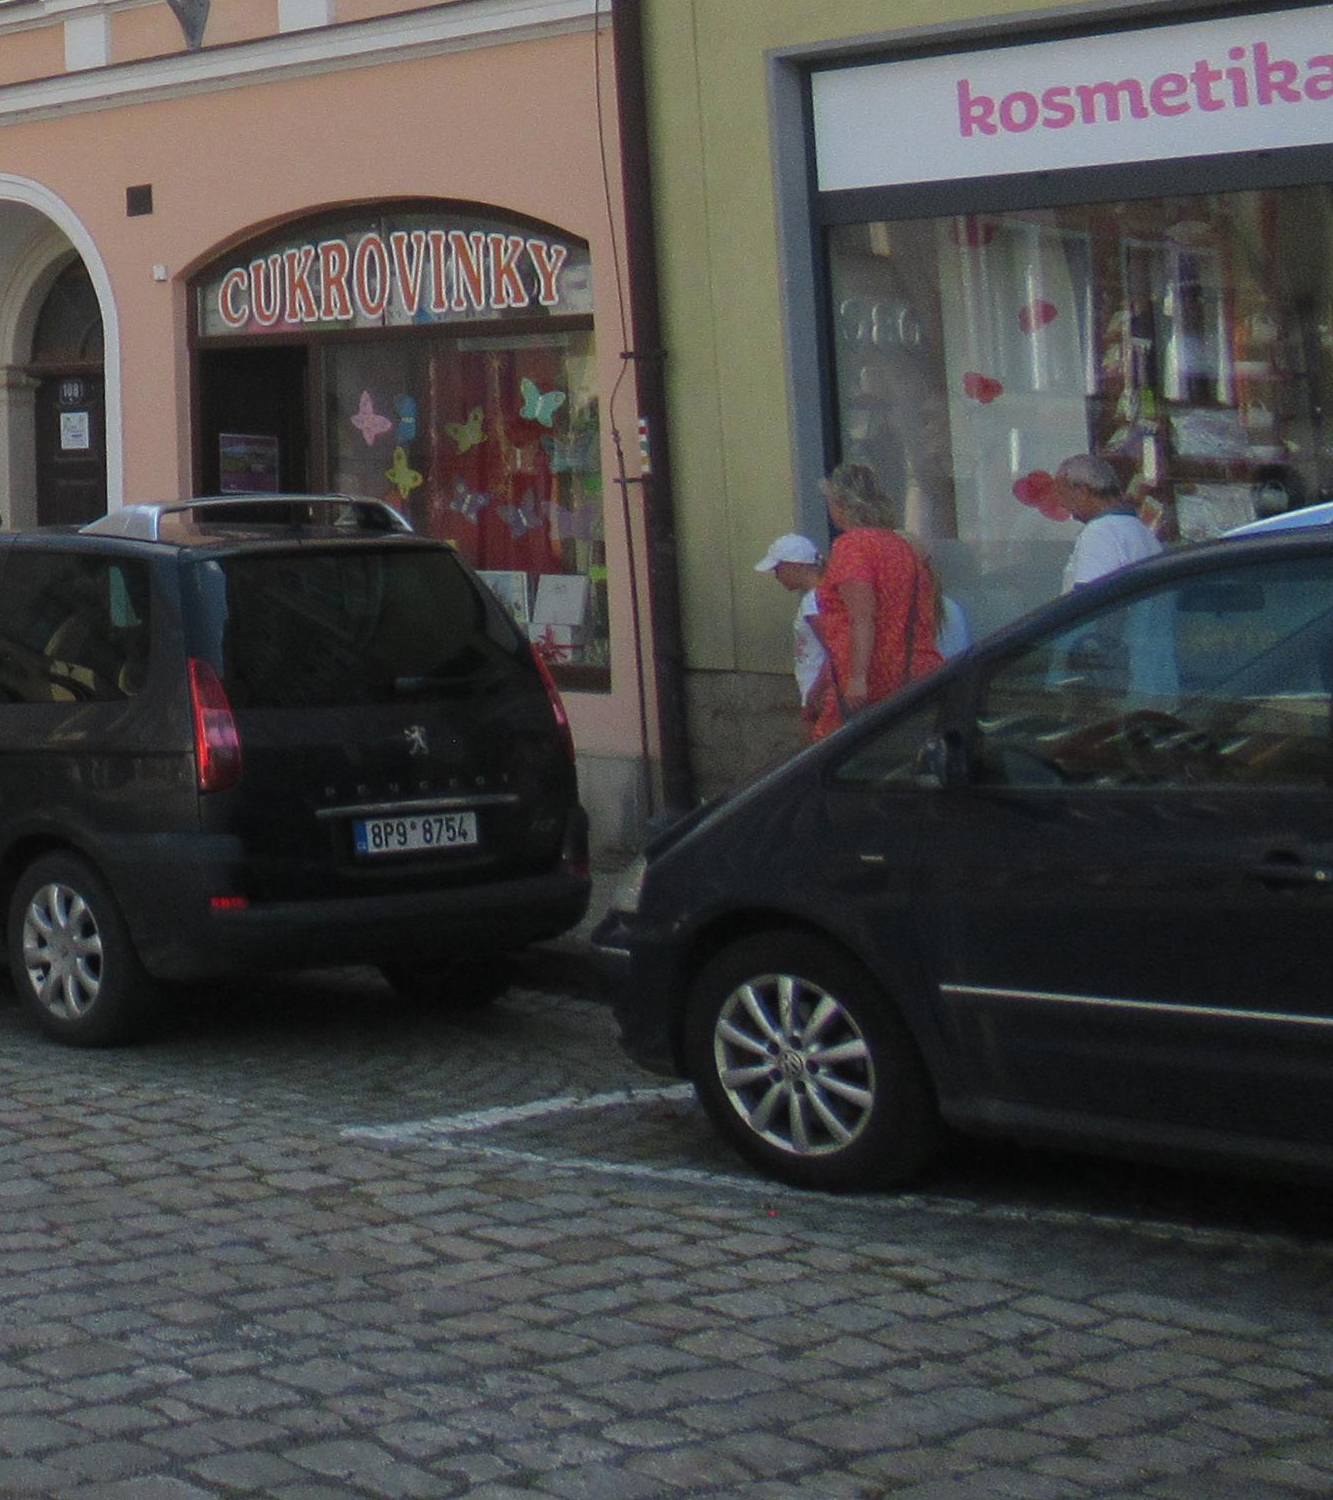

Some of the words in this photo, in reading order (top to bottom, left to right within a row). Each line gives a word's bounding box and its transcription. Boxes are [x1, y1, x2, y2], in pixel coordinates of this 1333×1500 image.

[957, 41, 1333, 138] kosmetika
[218, 230, 568, 328] CUKROVINKY
[371, 821, 409, 849] 8P9
[423, 815, 469, 845] 8754
